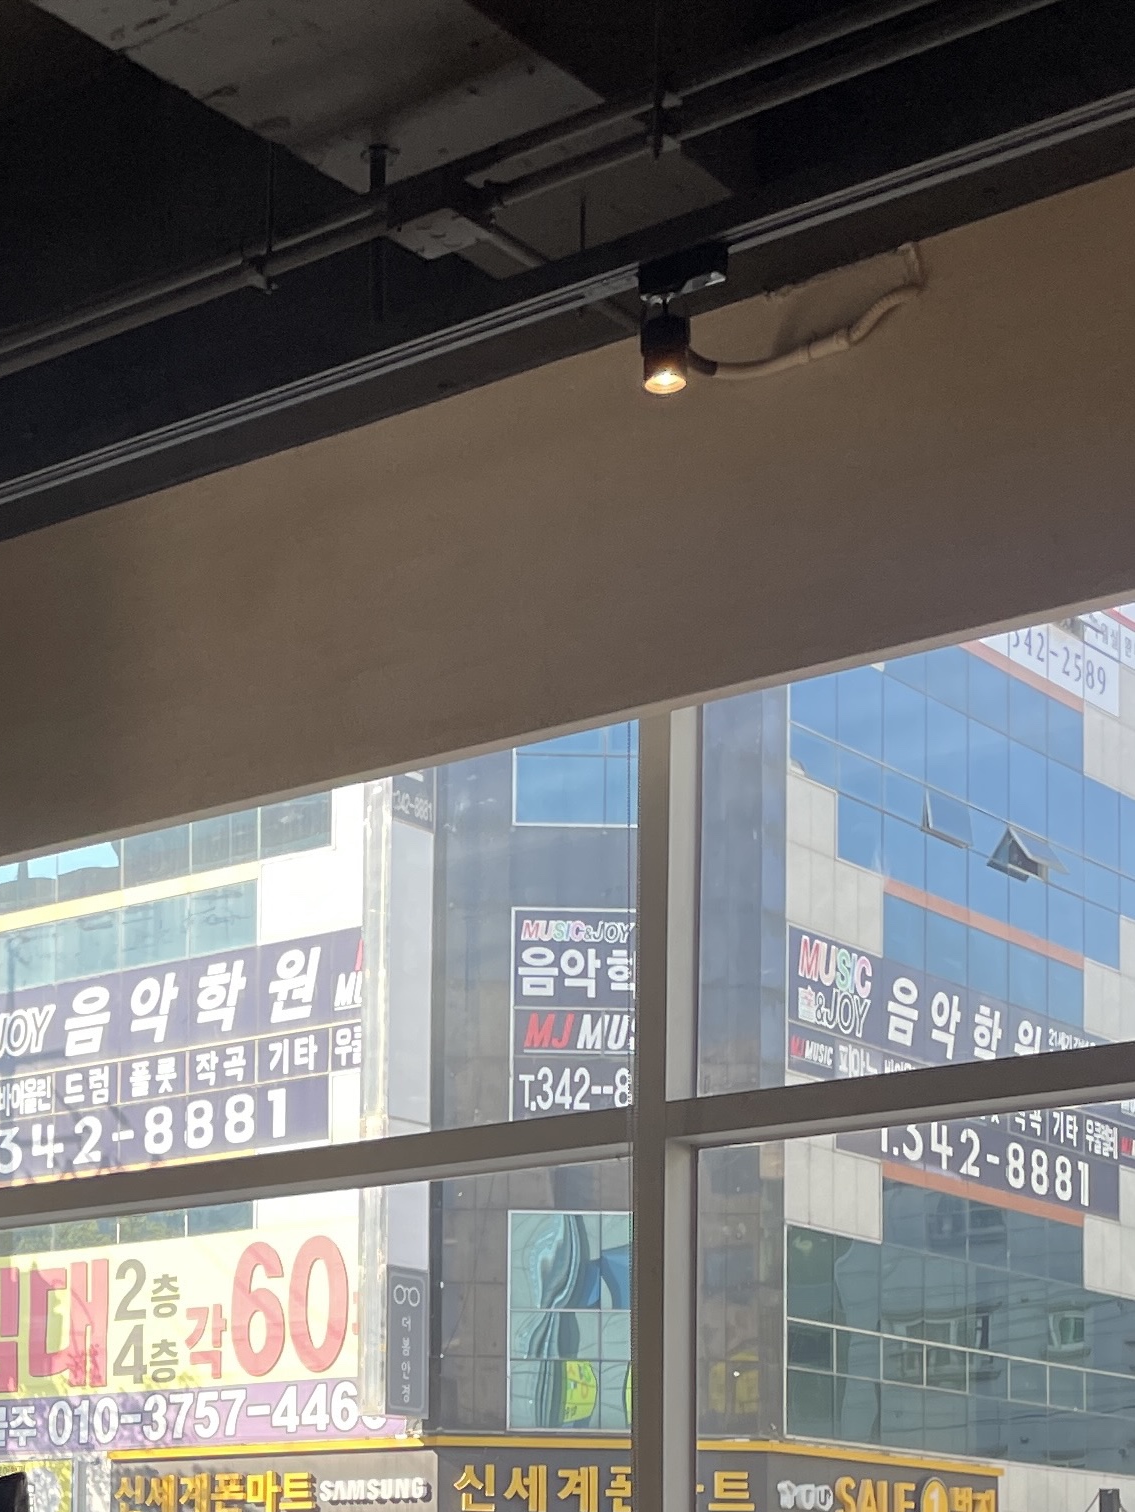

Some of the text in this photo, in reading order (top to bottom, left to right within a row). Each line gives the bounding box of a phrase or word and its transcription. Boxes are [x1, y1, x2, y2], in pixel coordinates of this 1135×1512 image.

[798, 935, 872, 999] MUSIC
[64, 946, 321, 1057] 음악학원
[524, 1012, 575, 1048] MJ
[804, 1040, 834, 1066] MUSIC
[64, 1066, 110, 1105] 드럼
[196, 1045, 246, 1086] 작곡
[269, 1034, 318, 1075] 기타
[1053, 1111, 1078, 1147] 기타
[114, 1258, 181, 1322] 2층
[185, 1303, 227, 1379] 각
[231, 1235, 349, 1377] 60
[113, 1324, 180, 1385] 4층
[319, 1476, 427, 1502] SAMSUNG
[697, 1471, 755, 1512] 트
